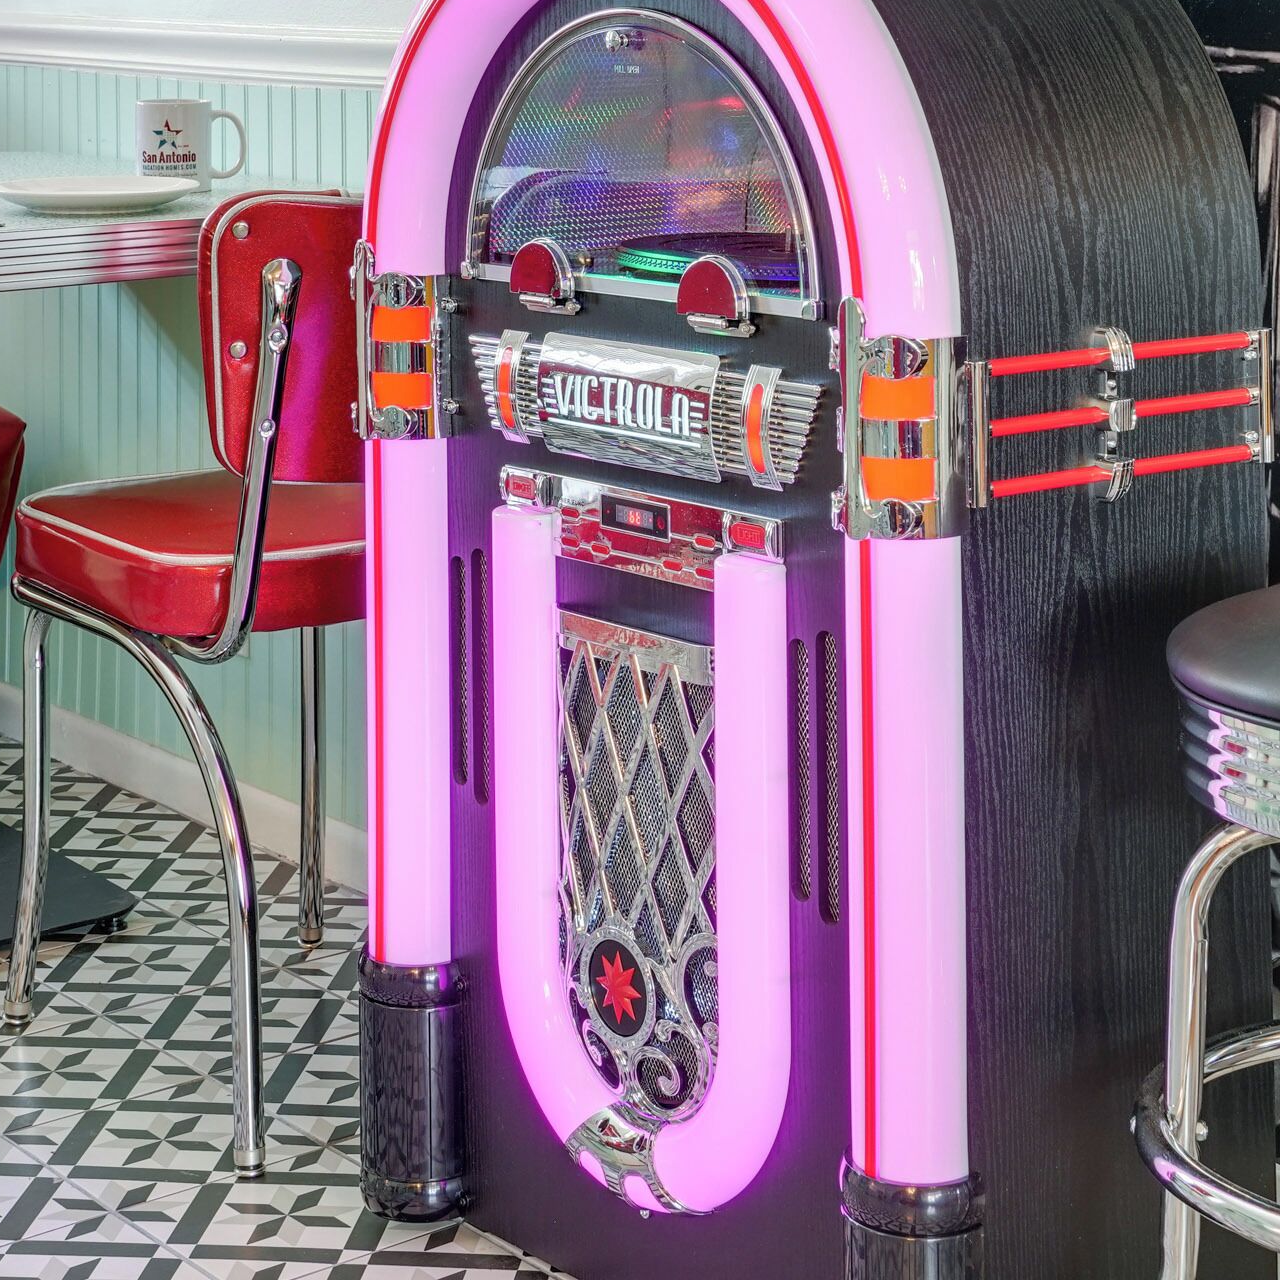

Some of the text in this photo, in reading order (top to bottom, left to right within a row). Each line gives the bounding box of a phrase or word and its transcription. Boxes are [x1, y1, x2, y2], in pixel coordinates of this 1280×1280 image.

[143, 151, 196, 163] San Antonio
[553, 373, 691, 438] VICTROLA
[737, 527, 761, 545] LIGHT
